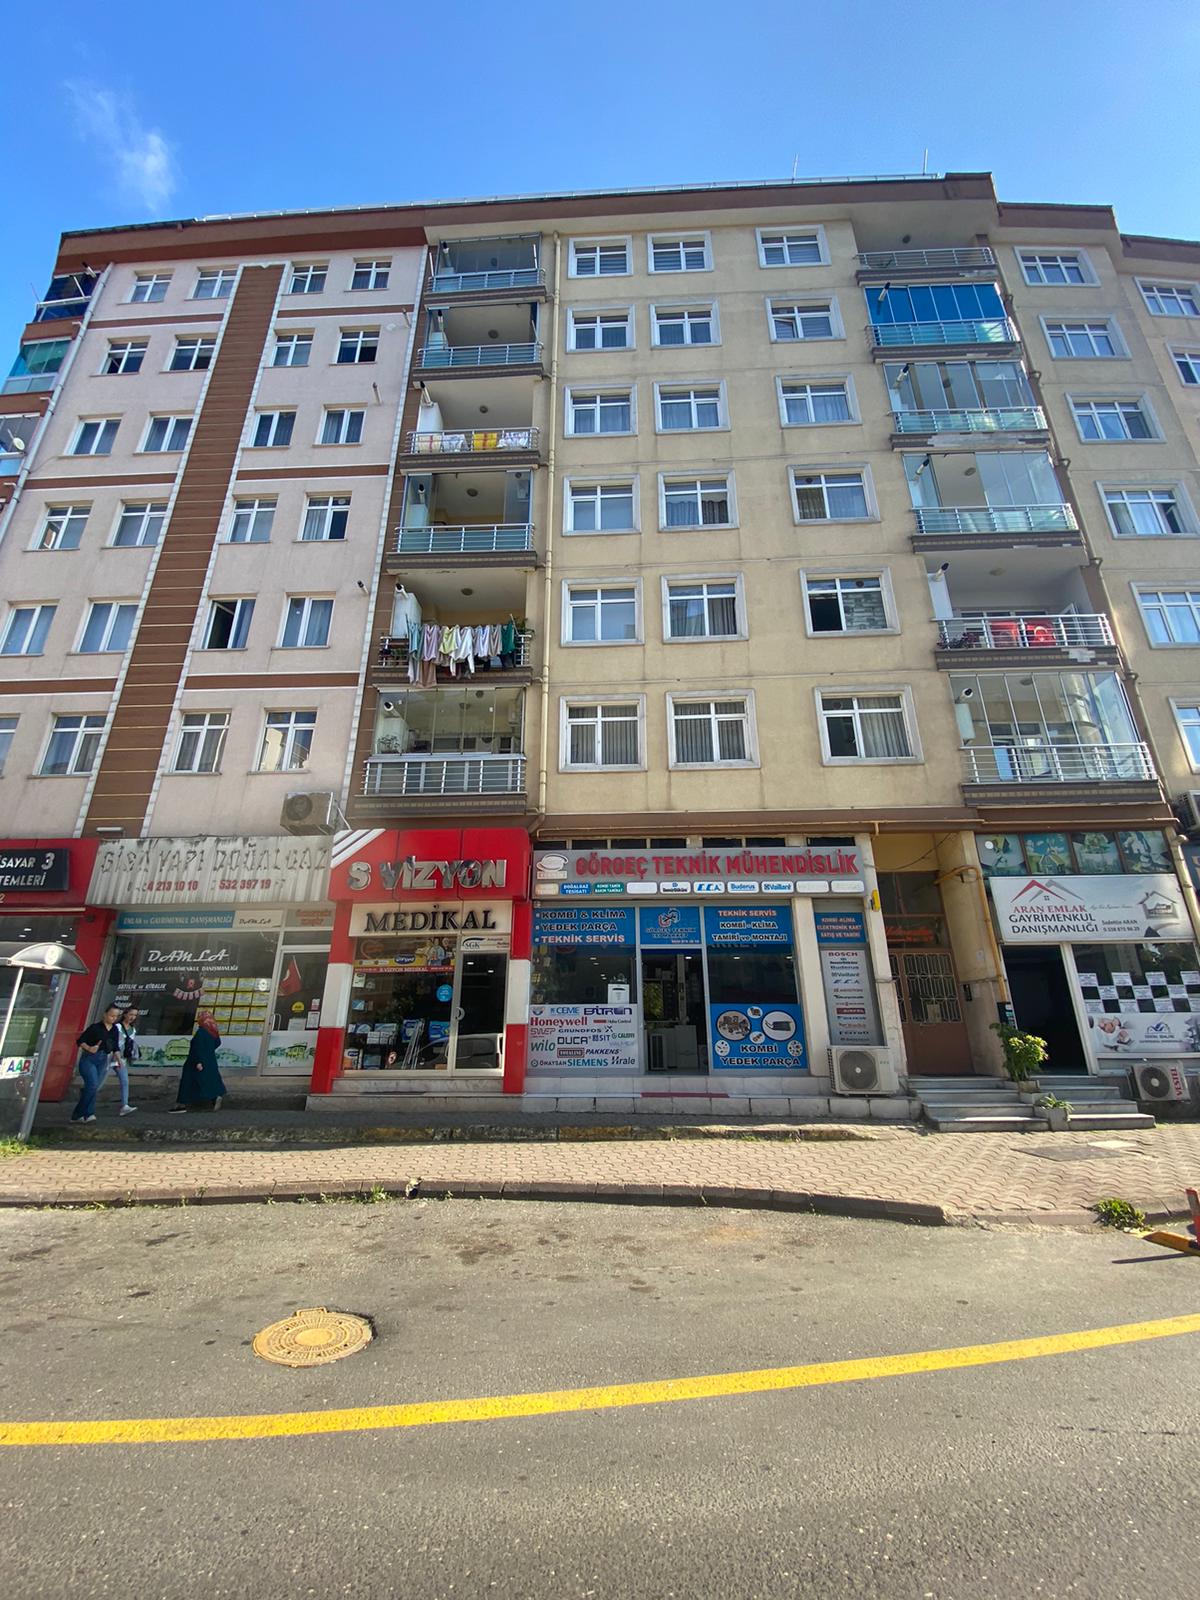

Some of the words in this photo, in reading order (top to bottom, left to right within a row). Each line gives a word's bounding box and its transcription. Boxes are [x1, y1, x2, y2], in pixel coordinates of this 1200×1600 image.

[41, 852, 55, 870] 3
[575, 852, 647, 879] GÖRGEÇ
[651, 850, 720, 876] TEKNİK
[725, 848, 860, 876] MÜHENDİSLİK
[349, 861, 372, 890] S
[379, 855, 508, 890] VİZYON
[219, 879, 237, 890] 532
[730, 883, 756, 891] Buderus
[541, 909, 577, 919] KOMBİ
[580, 911, 588, 919] &
[591, 909, 626, 919] KLİMA
[718, 909, 747, 917] TEKNİK
[749, 908, 777, 917] SERVİS
[1013, 905, 1047, 913] ARAN
[1048, 904, 1087, 913] EMLAK
[364, 904, 496, 932] MEDİKAL
[1008, 912, 1096, 923] GAYRİMENKUL
[541, 922, 578, 931] YEDEK
[581, 922, 617, 932] PARÇA
[720, 921, 746, 929] KOMBİ
[752, 920, 778, 929] KLİMA
[1012, 922, 1099, 934] DANIŞMANLIĞI
[541, 933, 583, 943] TEKNİK
[585, 933, 625, 943] SERVİS
[712, 933, 740, 942] TAMİRİ
[751, 933, 787, 942] MONTAJI
[148, 949, 230, 962] DAMLA
[530, 1016, 587, 1027] Honeywell
[530, 1040, 556, 1052] wilo
[740, 1043, 778, 1053] KOMBİ
[567, 1059, 608, 1067] SIEMENS
[720, 1057, 759, 1066] YEDEK
[762, 1057, 800, 1068] PARÇA
[1170, 1067, 1183, 1096] VESTEL
